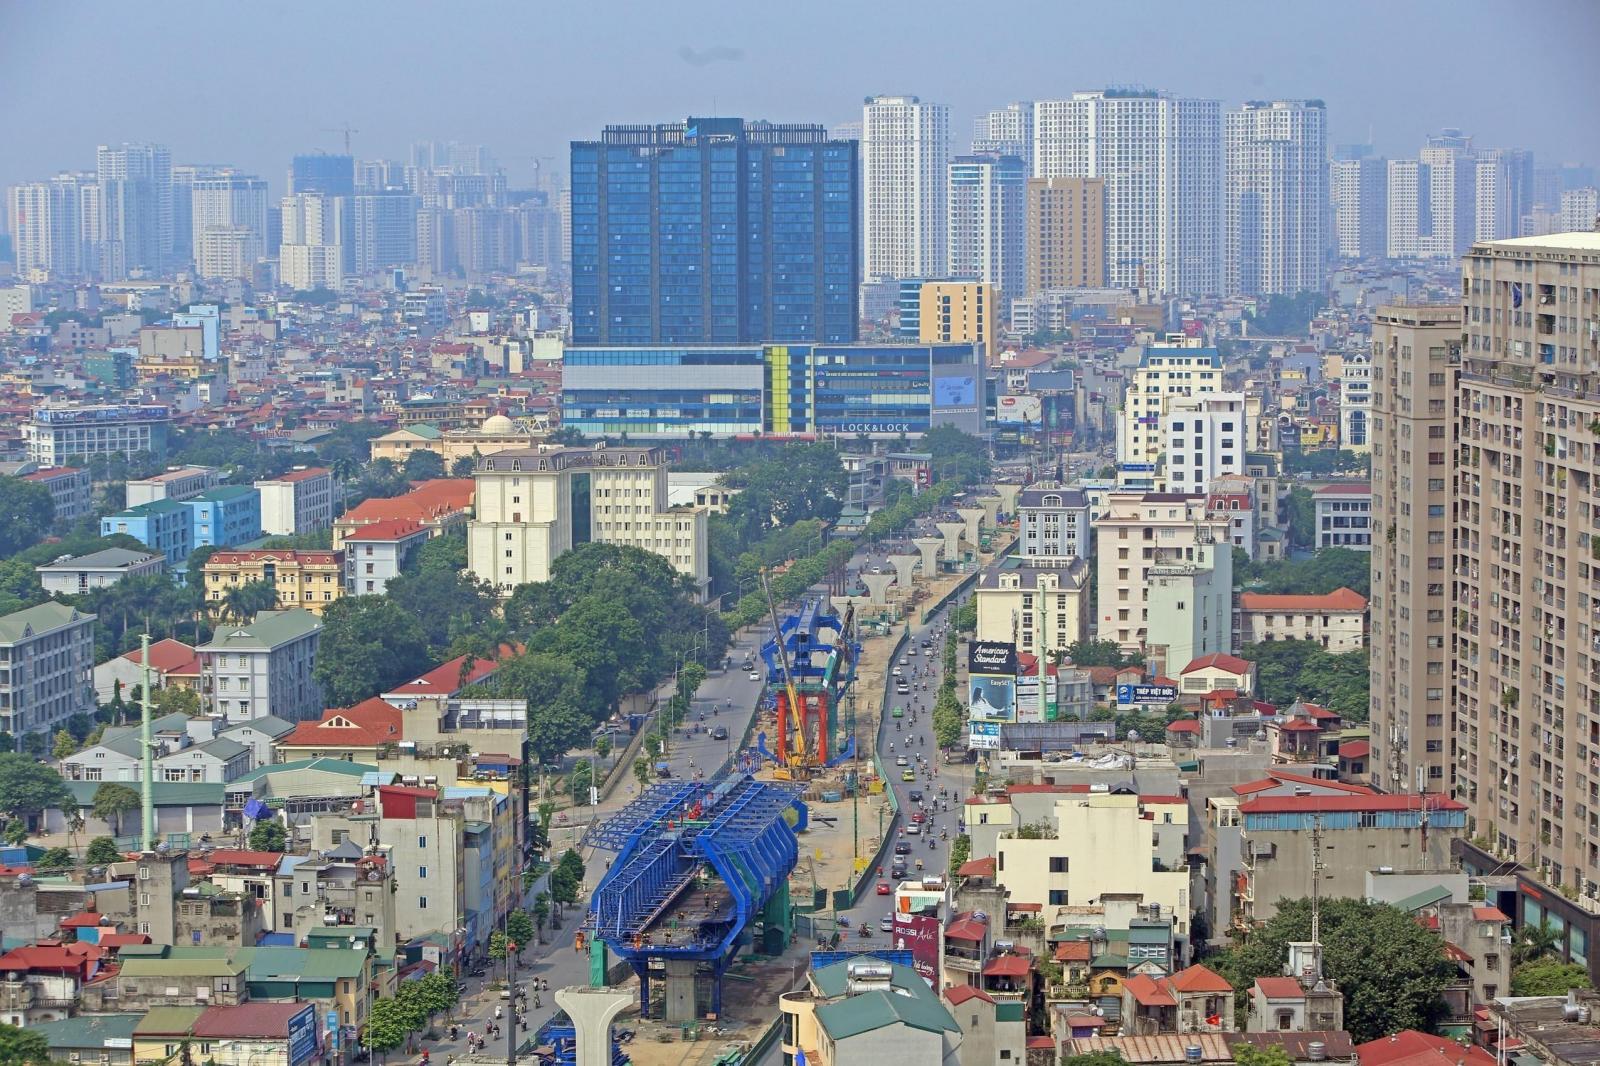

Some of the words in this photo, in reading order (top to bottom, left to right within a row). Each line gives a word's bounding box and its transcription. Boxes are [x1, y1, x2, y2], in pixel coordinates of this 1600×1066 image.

[841, 423, 909, 432] LOCK&LOCK
[974, 644, 1010, 655] American
[973, 653, 1007, 664] Standard
[895, 927, 917, 936] ROSSI
